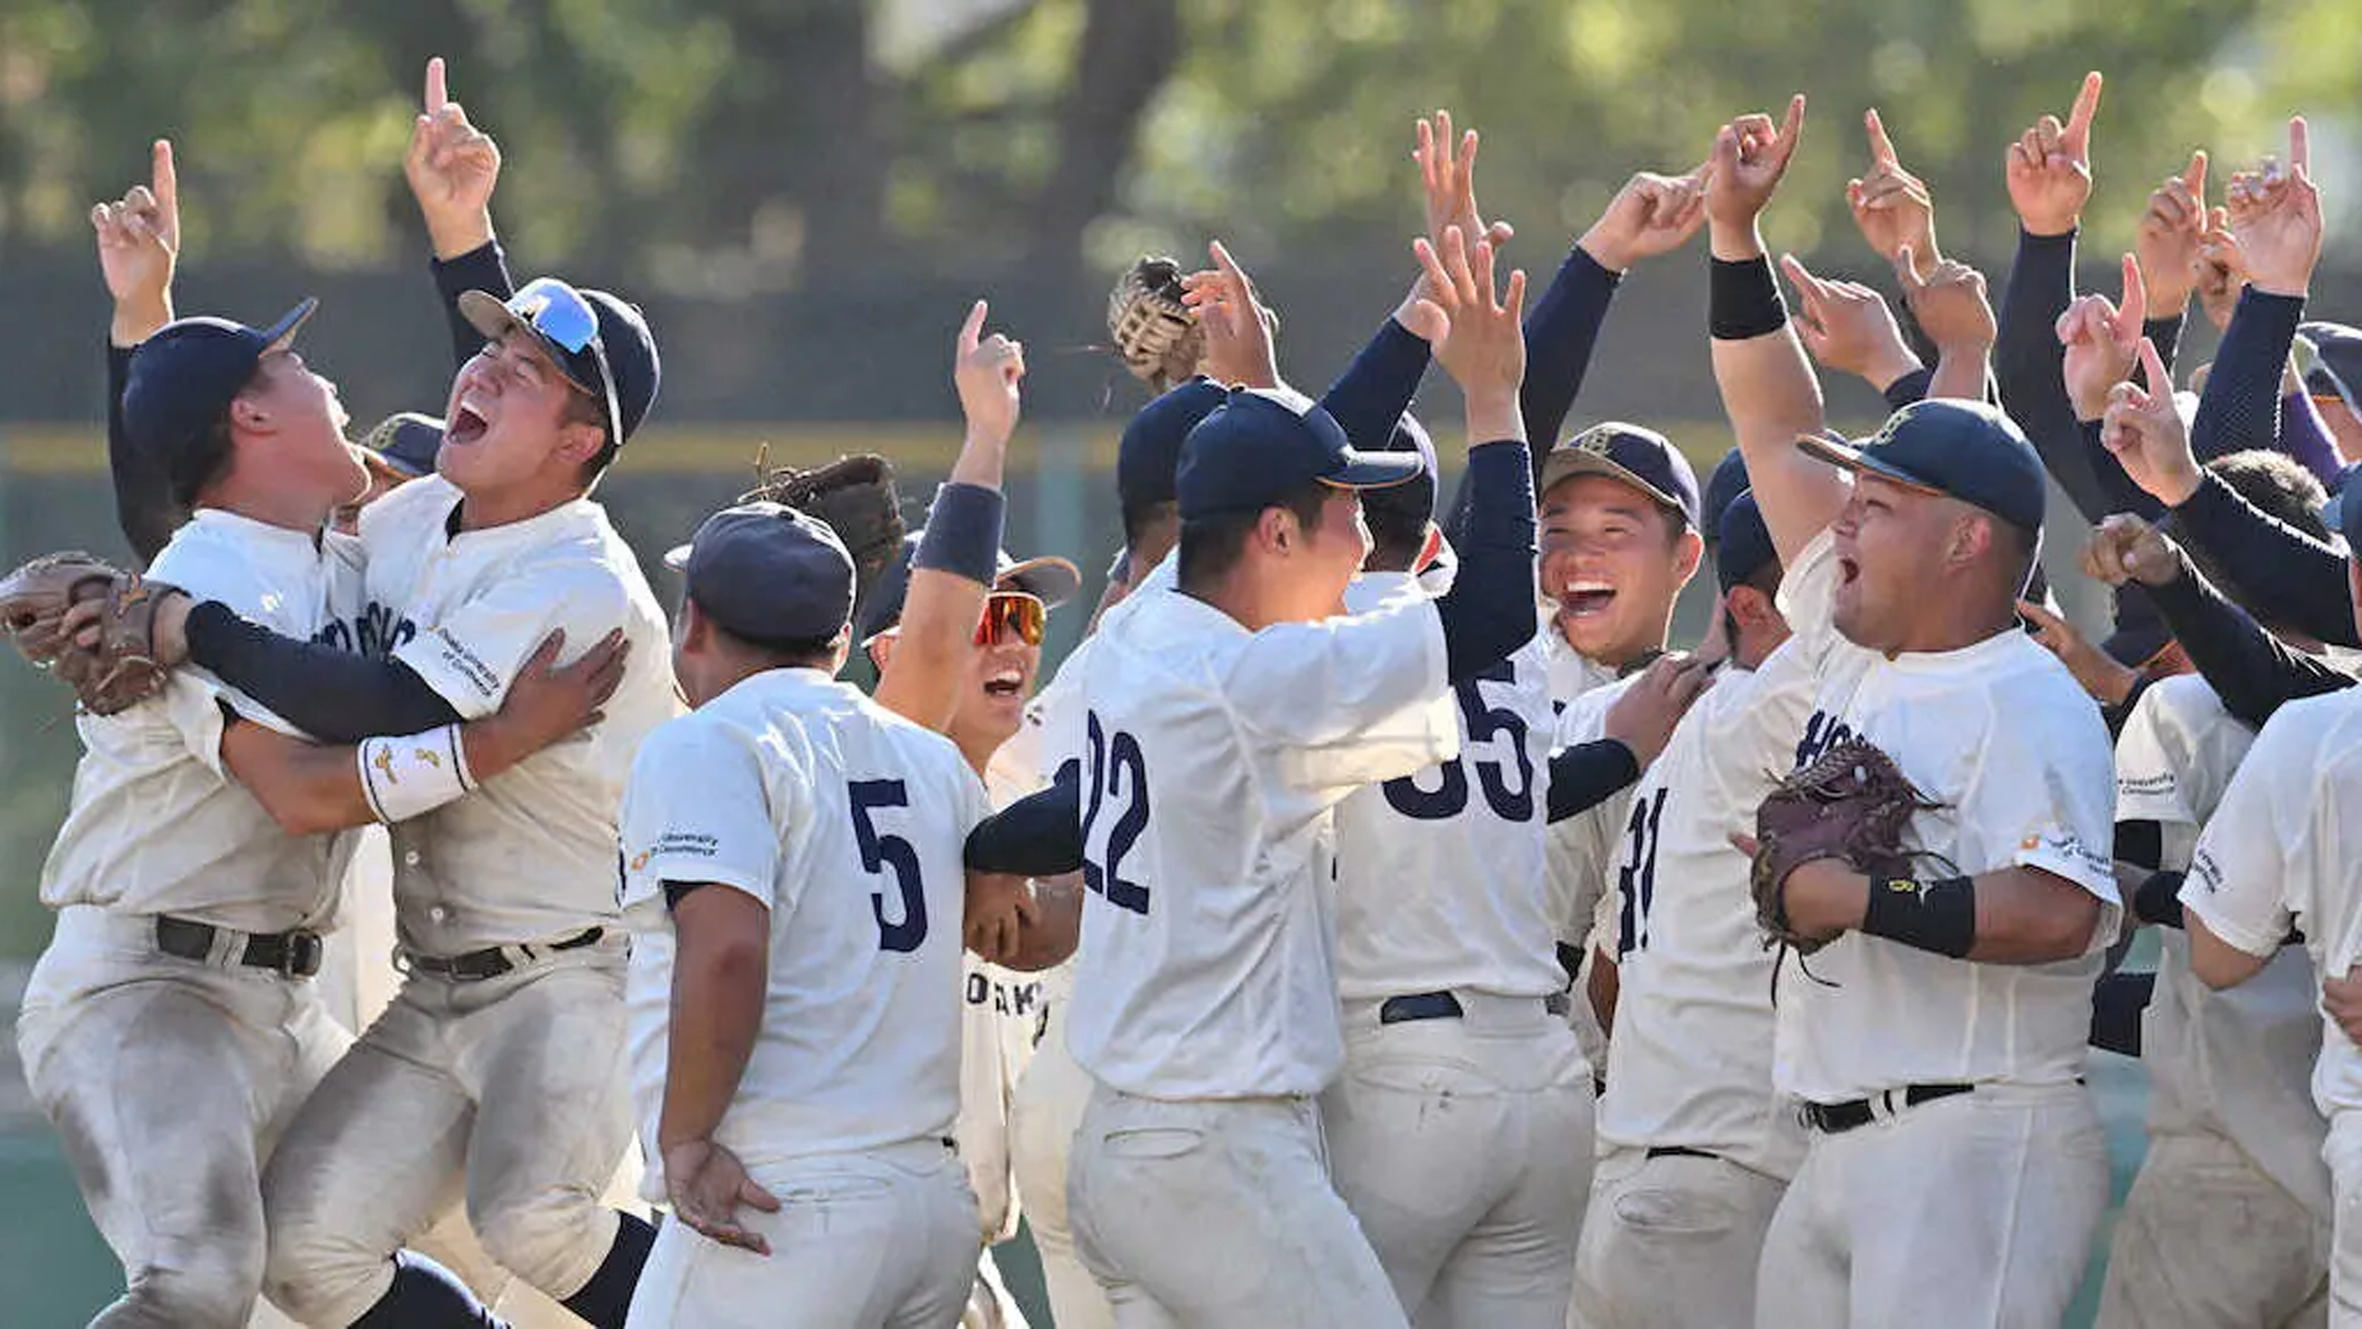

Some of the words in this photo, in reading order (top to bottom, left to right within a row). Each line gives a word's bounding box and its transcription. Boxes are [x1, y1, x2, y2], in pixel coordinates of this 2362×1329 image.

[451, 658, 492, 697] Commerce
[462, 651, 500, 690] University
[1078, 709, 1149, 915] 22
[849, 779, 928, 952] 5
